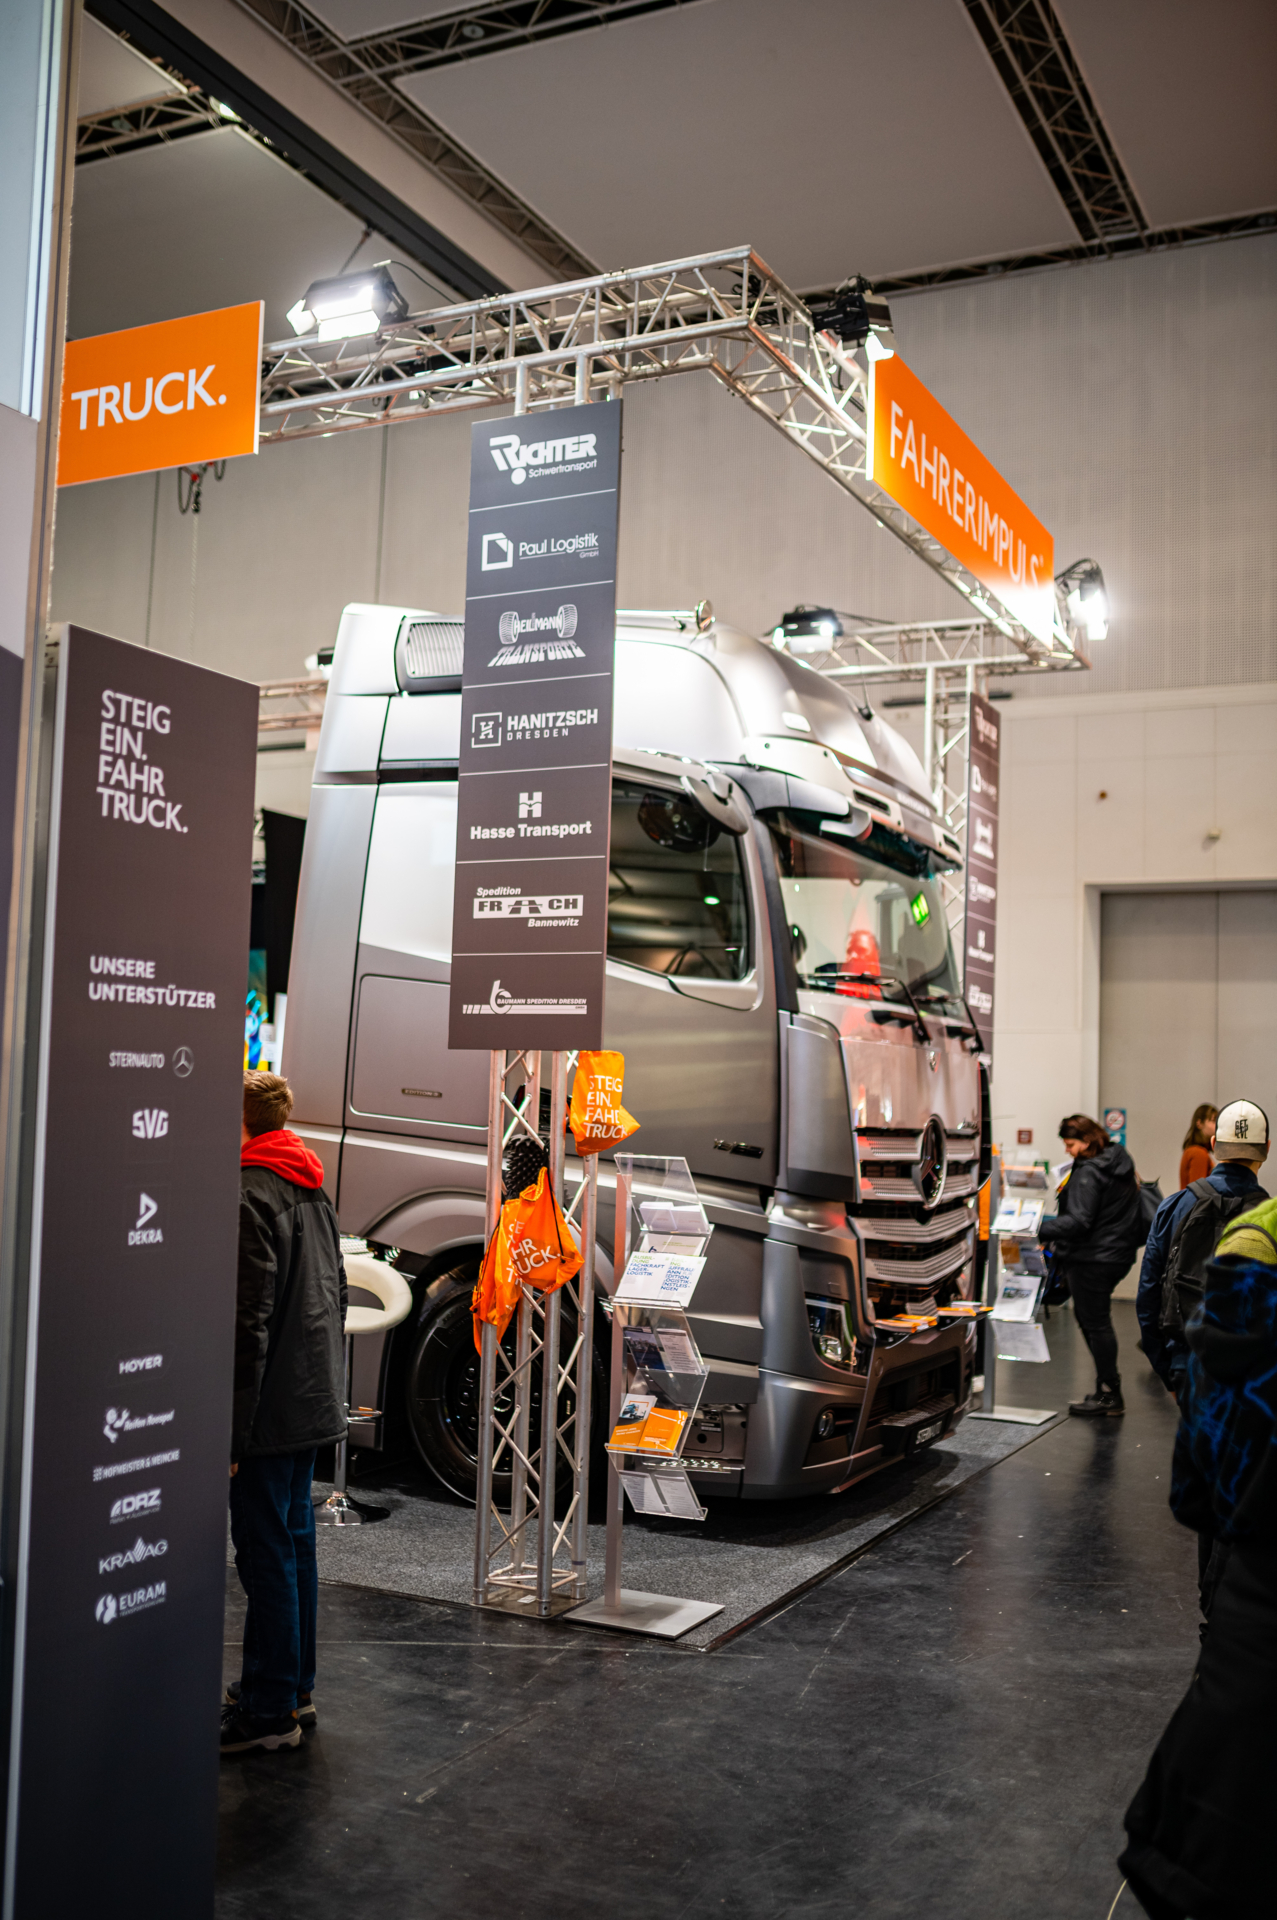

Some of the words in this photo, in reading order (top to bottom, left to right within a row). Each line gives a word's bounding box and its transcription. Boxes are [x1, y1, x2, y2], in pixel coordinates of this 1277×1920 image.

[71, 364, 227, 430] TRUCK.
[489, 433, 597, 471] RICHTER
[528, 459, 597, 478] Schwertransport
[519, 539, 547, 556] Paul
[551, 532, 599, 553] Logistik
[579, 550, 599, 558] GmbH
[487, 639, 586, 667] TRANSPORTE
[100, 689, 171, 734] STEIG
[507, 708, 598, 731] HANITZSCH
[100, 721, 148, 761] EIN.
[507, 728, 568, 740] DRESDEN
[98, 754, 166, 797] FAHR
[96, 786, 189, 833] TRUCK.
[470, 826, 515, 839] Hasse
[518, 821, 592, 838] Transport
[477, 886, 521, 897] Spedition
[528, 918, 579, 927] Bannewitz
[90, 955, 156, 979] UNSERE
[89, 981, 216, 1009] UNTERSTÜTZER
[109, 1051, 165, 1069] STERNAUTO
[589, 1075, 622, 1092] STEIG
[587, 1091, 612, 1107] EIN.
[132, 1108, 169, 1139] SVG
[128, 1229, 163, 1245] DEKRA
[119, 1355, 163, 1374] HOYER
[103, 1459, 144, 1479] HOFMEISTER
[99, 1537, 168, 1574] KRAVAG
[119, 1581, 166, 1610] EURAM
